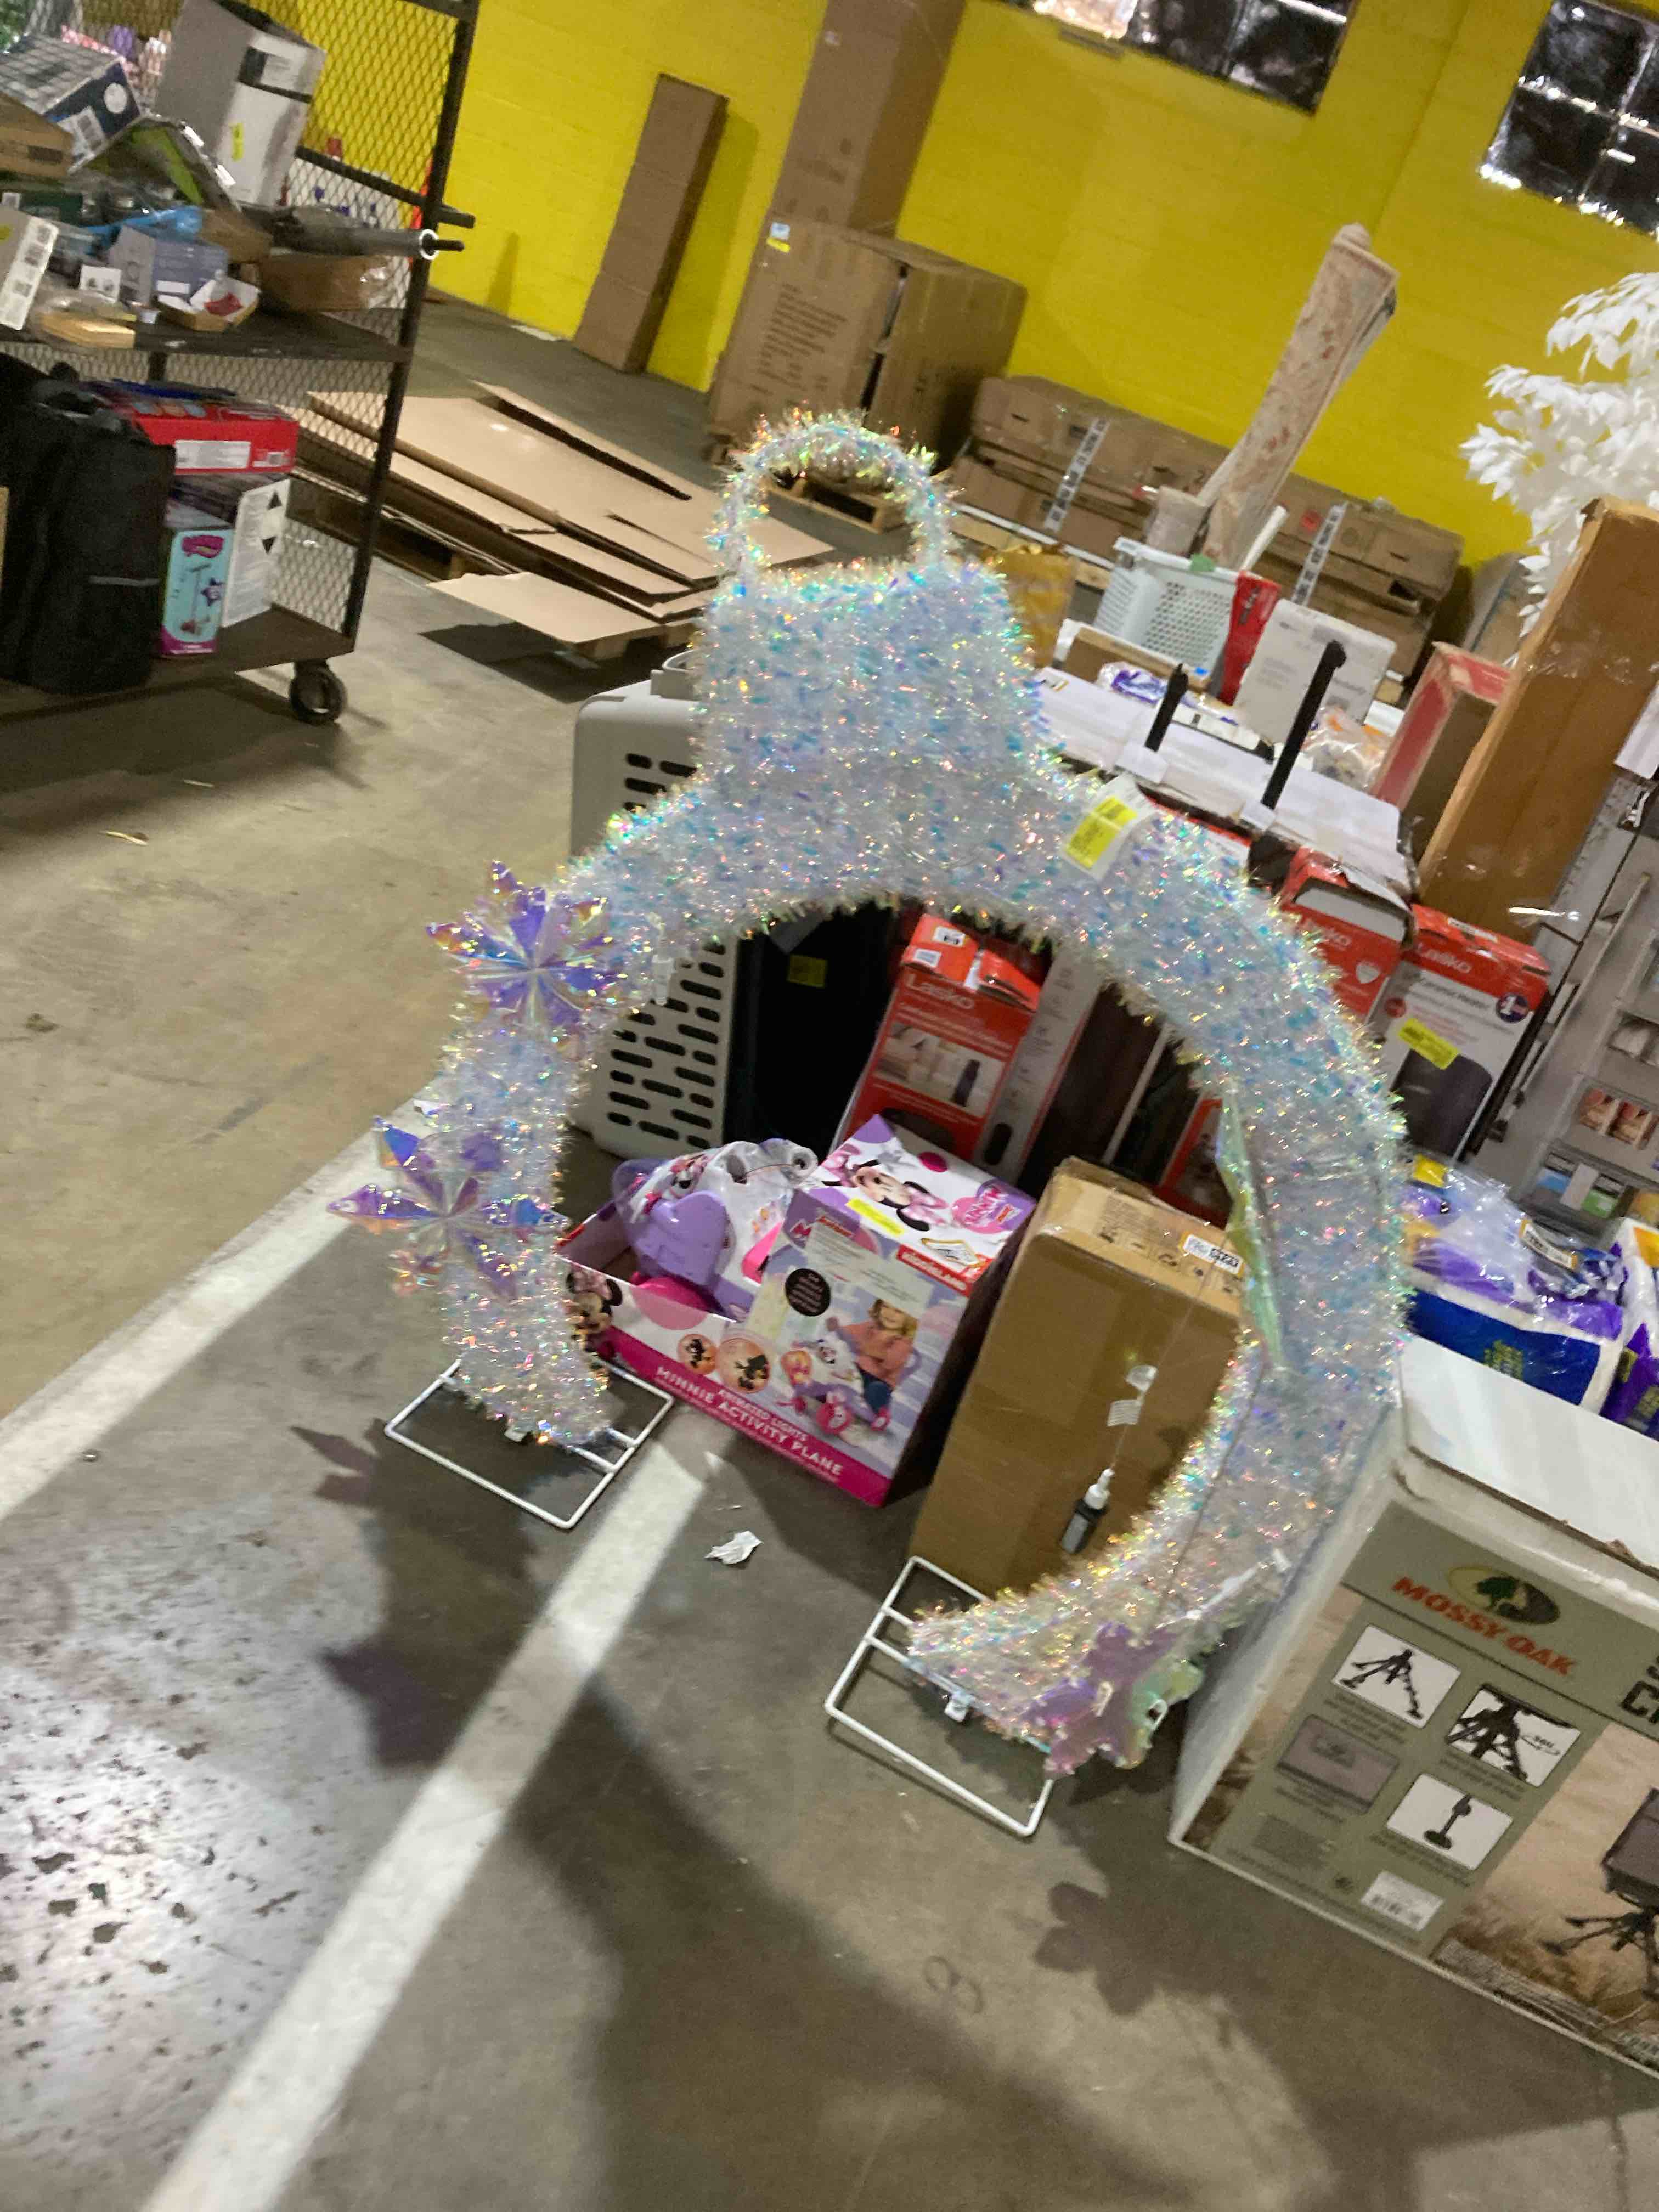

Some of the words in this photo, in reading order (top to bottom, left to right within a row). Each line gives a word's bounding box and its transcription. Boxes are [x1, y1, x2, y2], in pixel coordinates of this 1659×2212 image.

[1415, 941, 1472, 974] Lasko
[906, 973, 975, 1011] Lasko
[657, 1366, 715, 1404] MINNIE
[718, 1401, 789, 1444] ACTIVITY
[791, 1440, 844, 1476] PLANE
[774, 1415, 809, 1442] LIGHTS
[1392, 1577, 1508, 1639] MOSSY
[1504, 1635, 1576, 1677] OAK
